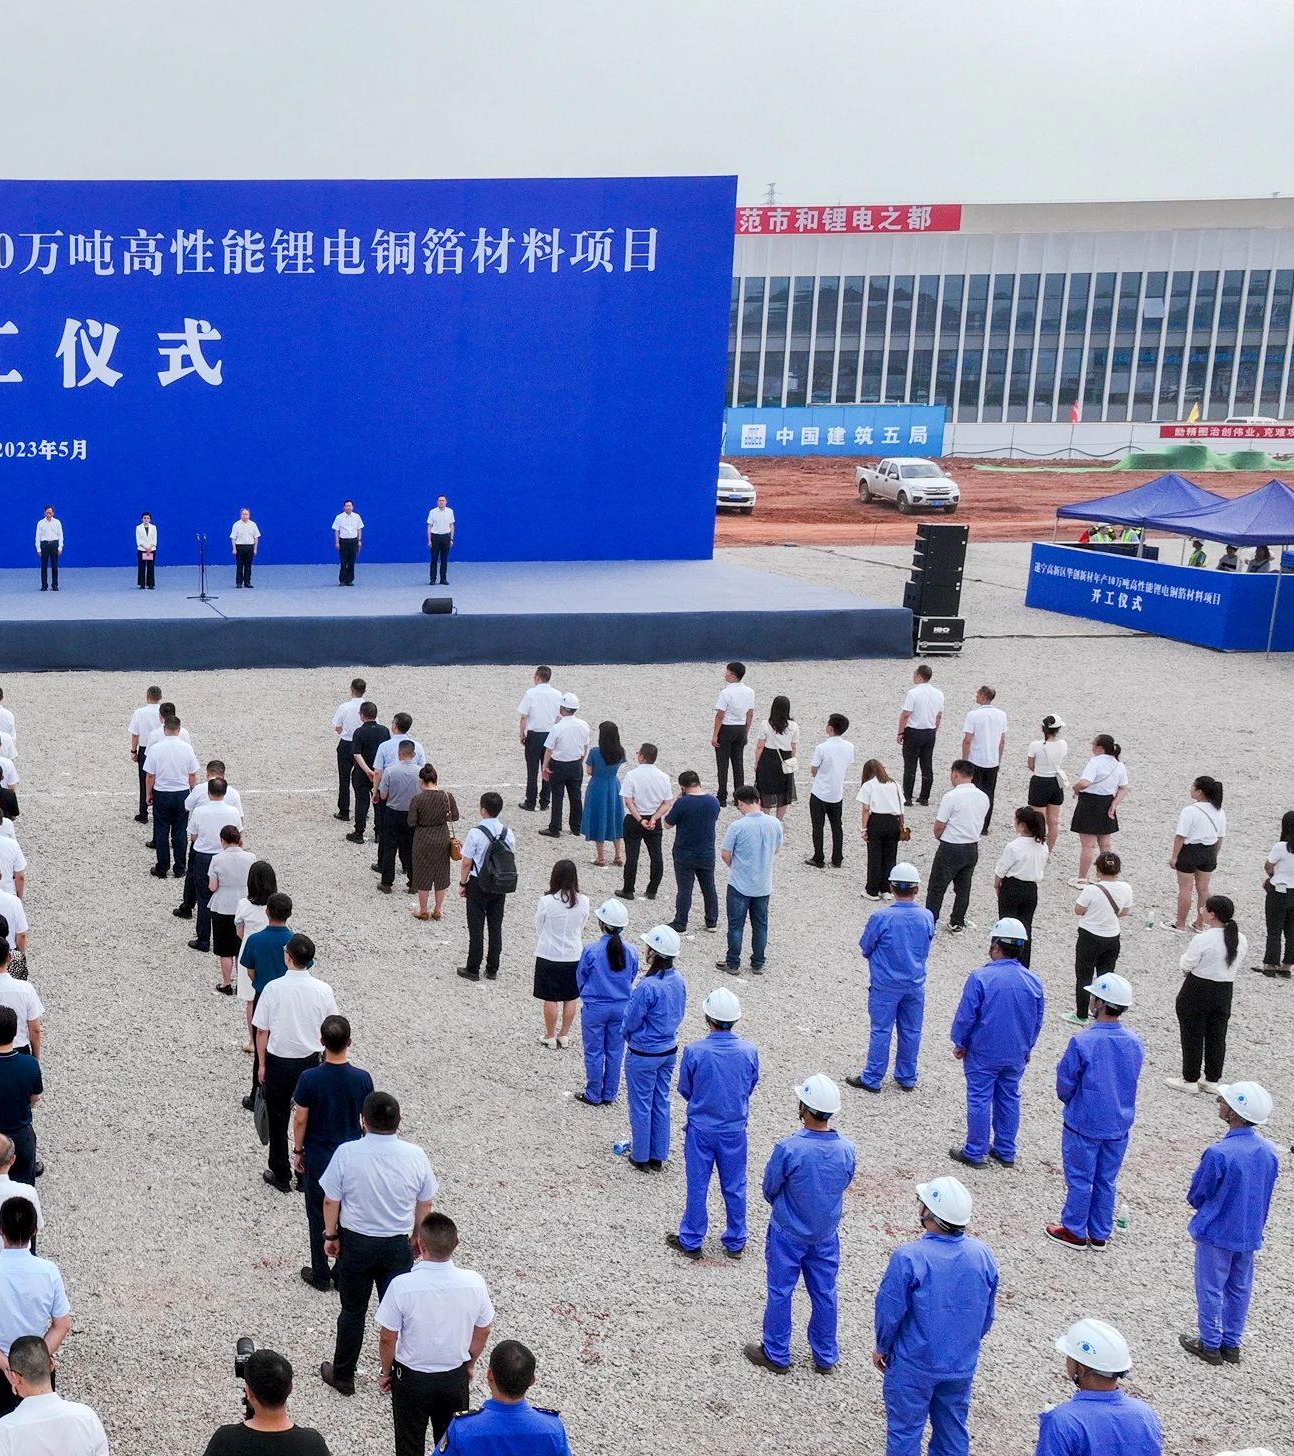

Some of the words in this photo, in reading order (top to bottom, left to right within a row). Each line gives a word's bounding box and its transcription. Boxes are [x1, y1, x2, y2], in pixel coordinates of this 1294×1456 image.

[740, 207, 932, 232] 范市和锂电之都
[776, 425, 928, 446] 中国建筑五局
[1091, 588, 1144, 612] 开工仪式
